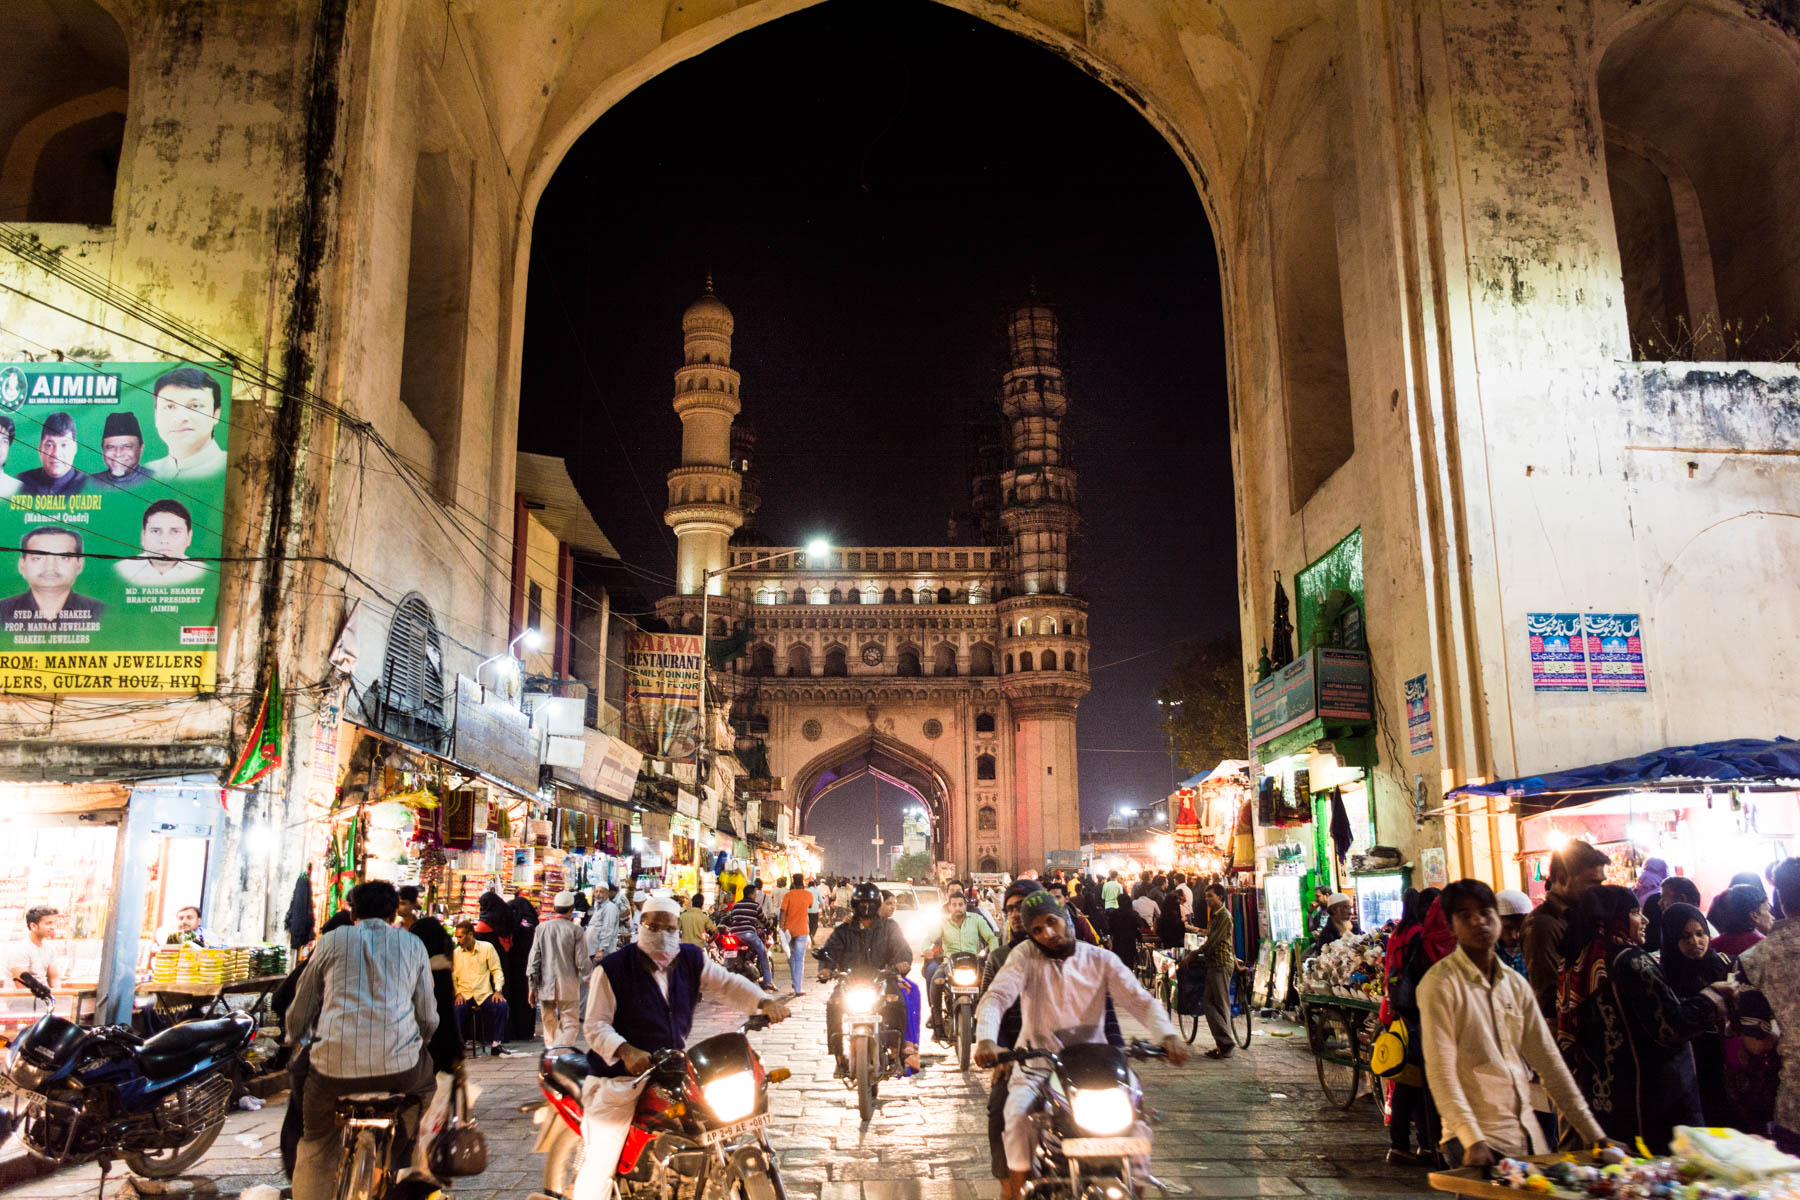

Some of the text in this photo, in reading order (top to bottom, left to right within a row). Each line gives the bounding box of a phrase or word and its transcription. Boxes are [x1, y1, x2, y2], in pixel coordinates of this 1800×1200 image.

[32, 375, 118, 396] AIMIM
[10, 494, 102, 513] SYED SOHAIL QUADRI
[62, 512, 89, 524] Quadri)
[13, 609, 33, 619] SYED
[59, 609, 92, 619] SHAKEEL
[4, 622, 101, 631] PROP. MANNAN JEWELLERS
[13, 634, 90, 644] SHAKEEL JEWELLERS
[630, 634, 701, 653] SALWA
[45, 656, 108, 668] MANNAN
[113, 655, 202, 668] JEWELLERS
[625, 653, 701, 669] RESTAURANT
[629, 669, 699, 680] FAMILY DINING
[53, 675, 113, 689] GULZAR
[119, 675, 164, 691] HOUZ,
[628, 679, 652, 687] HALL
[667, 680, 699, 690] FLOOR
[706, 1131, 717, 1142] AP
[735, 1122, 747, 1133] AE
